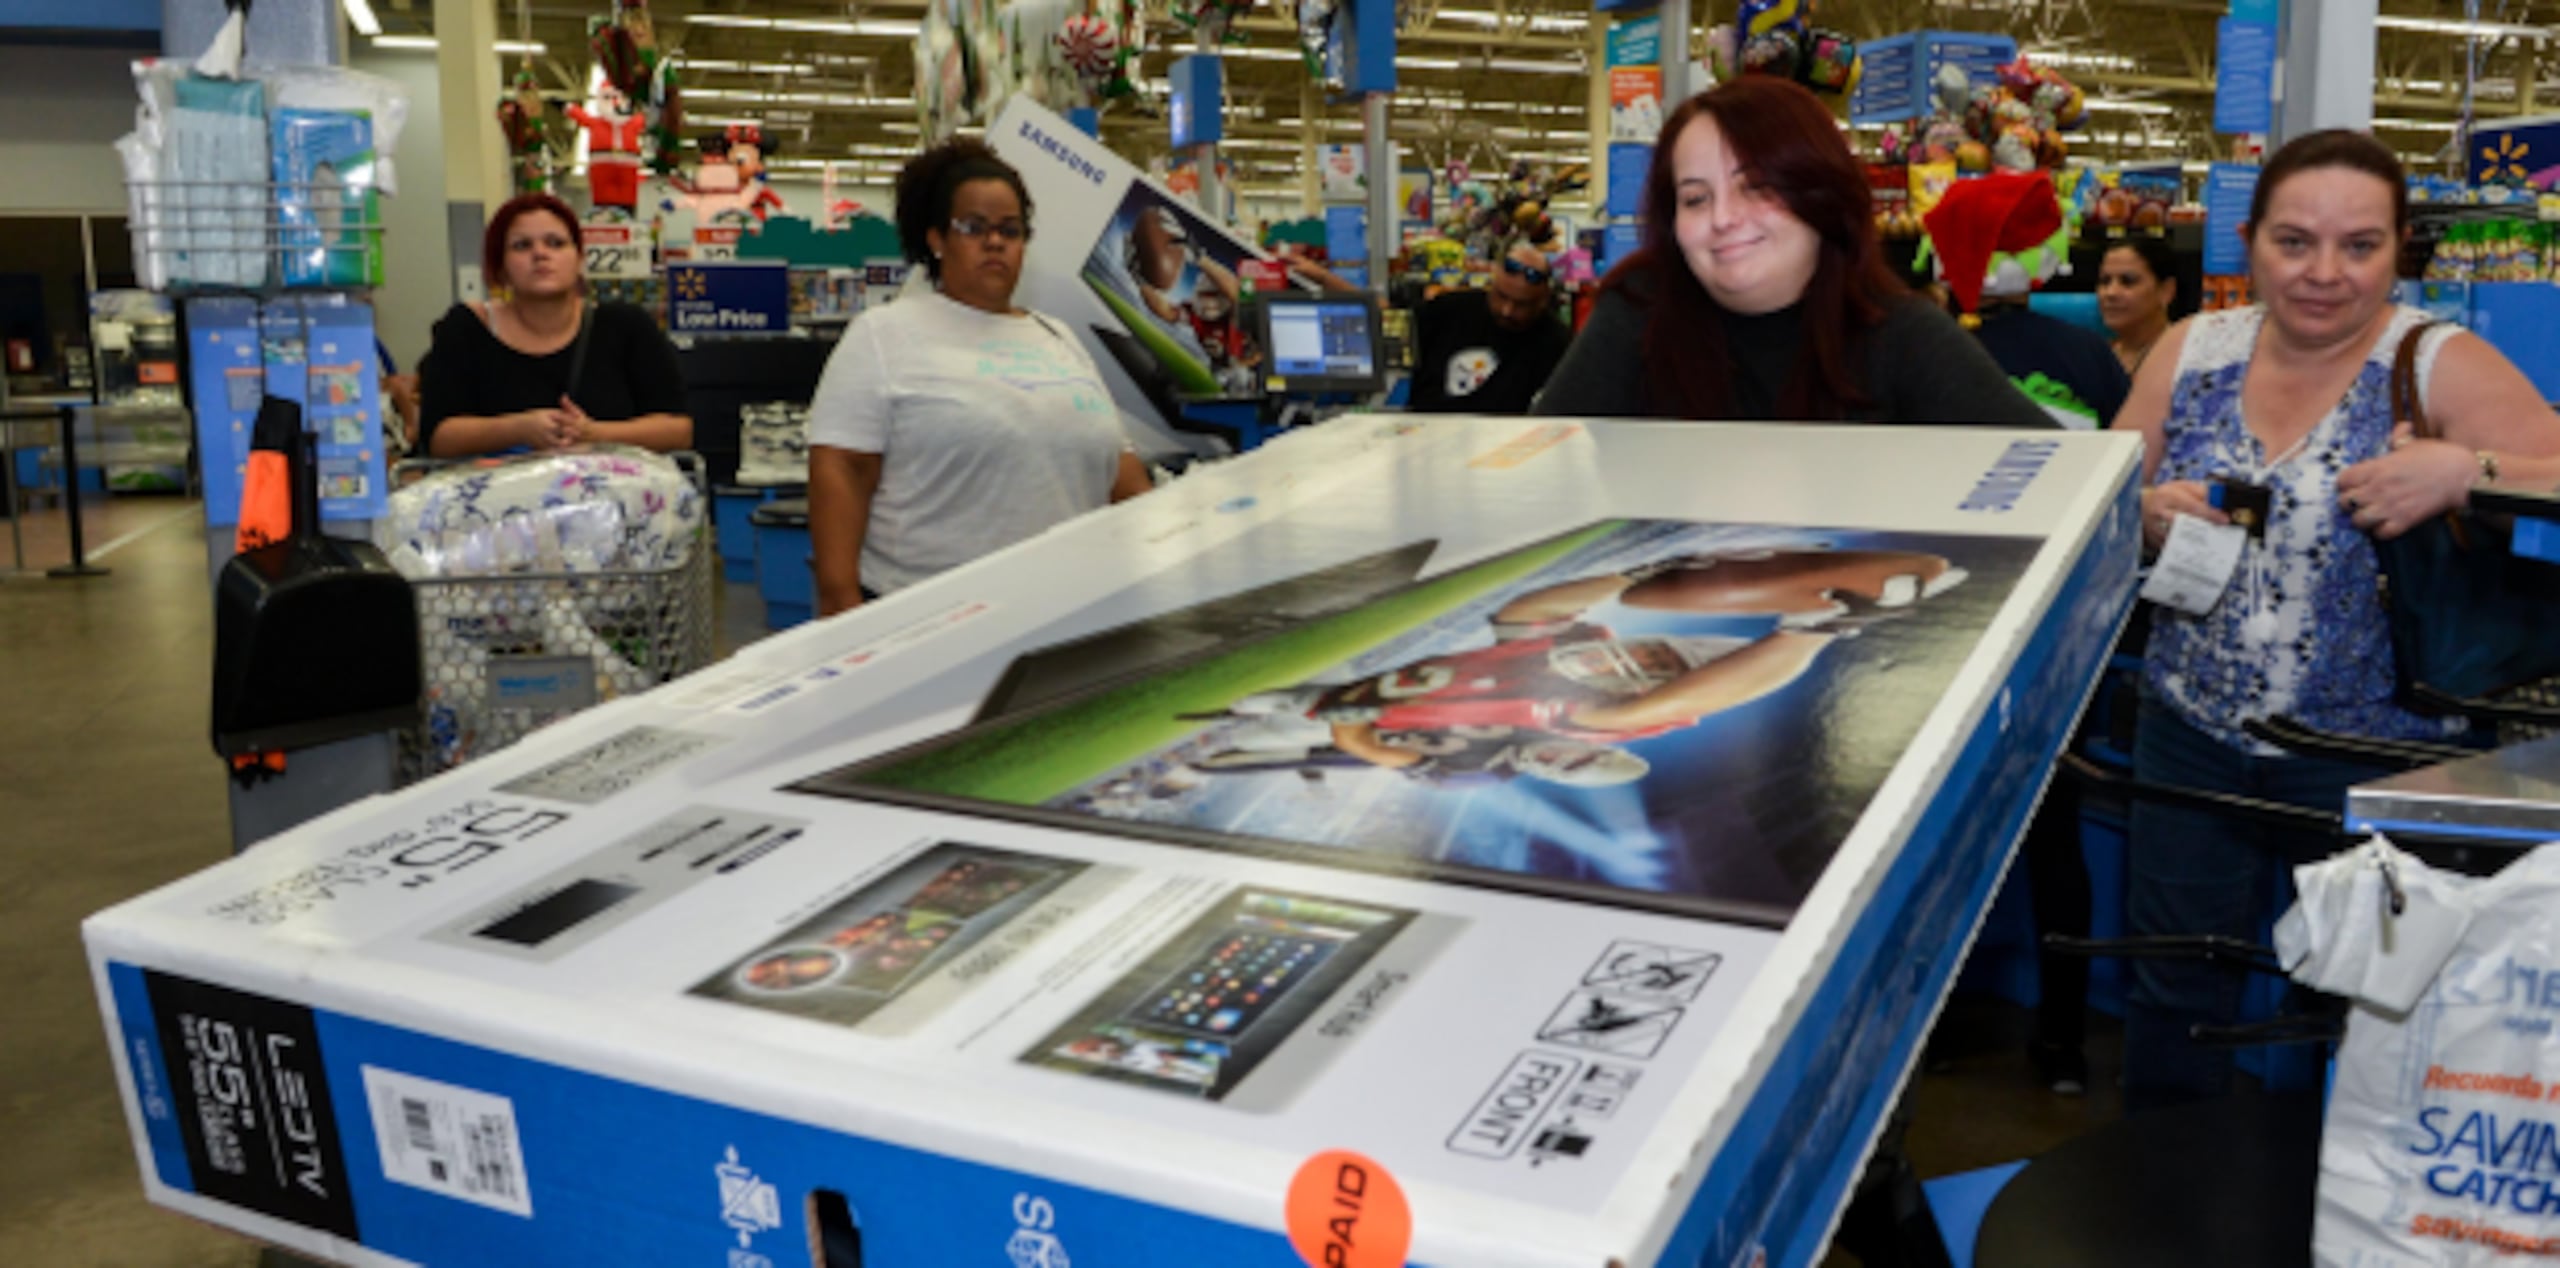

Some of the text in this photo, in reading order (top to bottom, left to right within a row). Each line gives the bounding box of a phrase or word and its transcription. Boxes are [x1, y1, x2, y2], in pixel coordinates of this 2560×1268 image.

[1019, 120, 1106, 184] SAMSUNG
[719, 308, 768, 329] Price
[1470, 1059, 1563, 1148] FRONT
[2423, 1064, 2543, 1100] Recuerda
[1324, 1162, 1368, 1268] PAID
